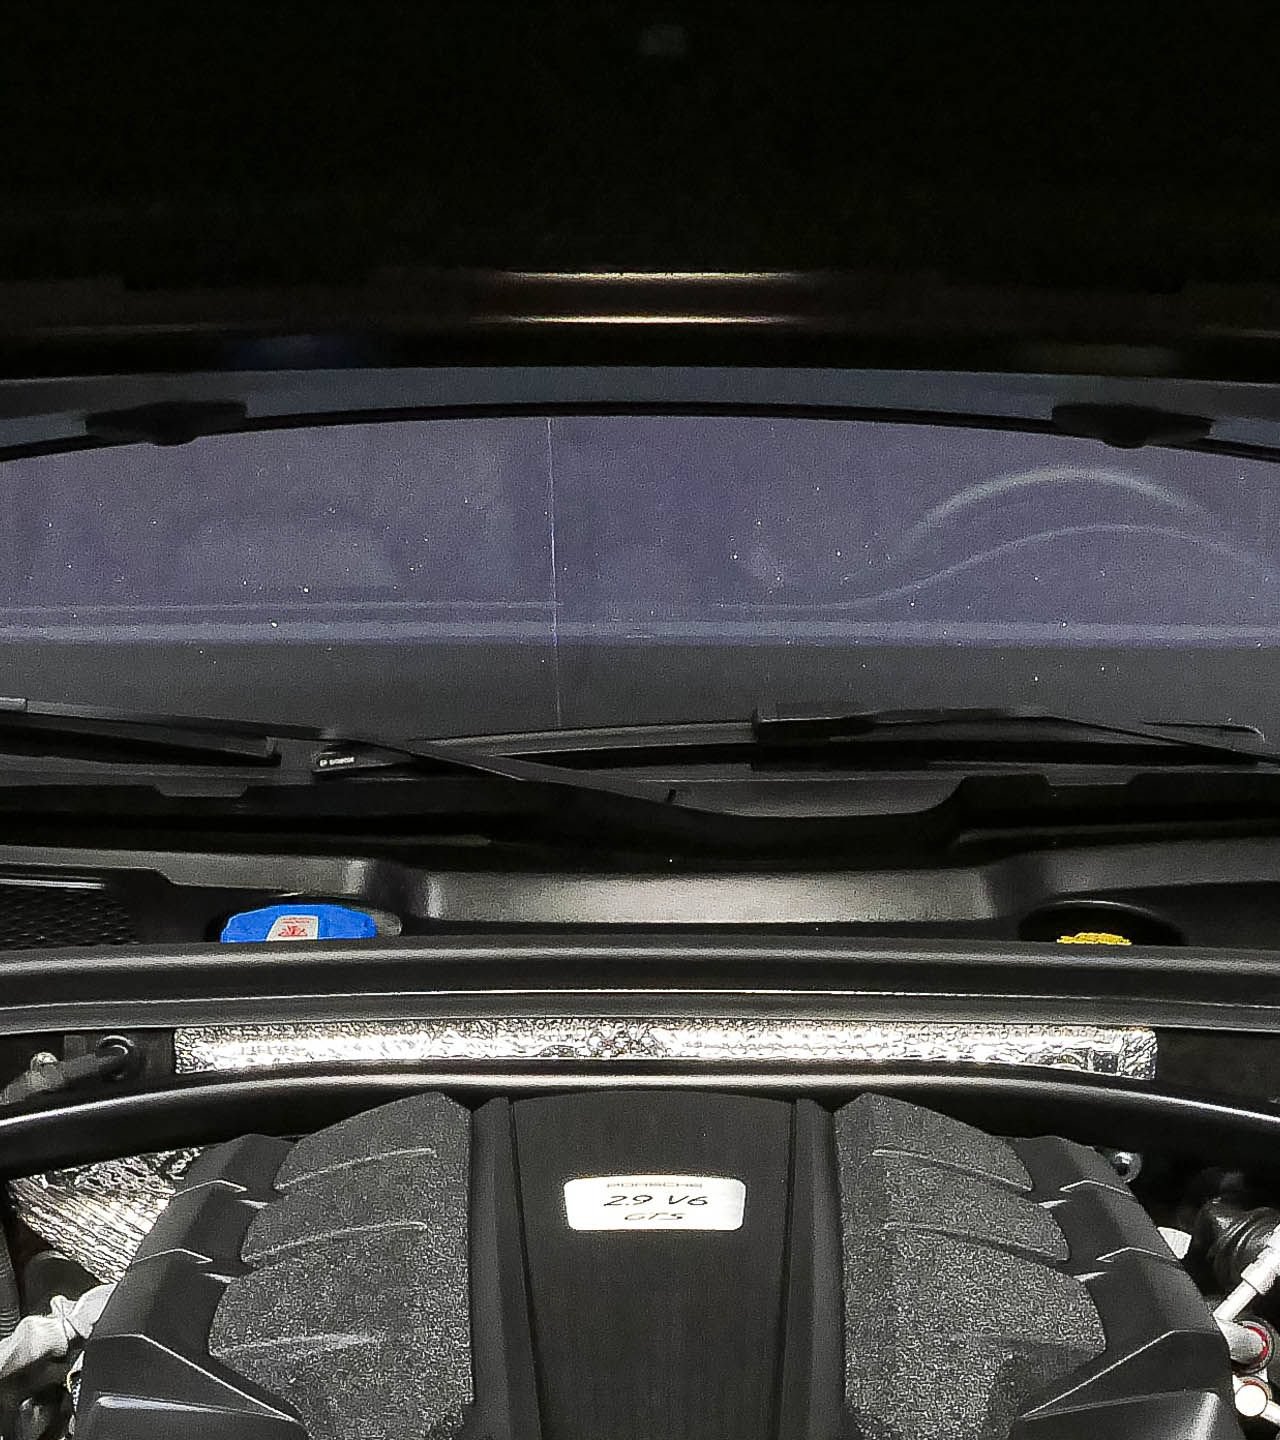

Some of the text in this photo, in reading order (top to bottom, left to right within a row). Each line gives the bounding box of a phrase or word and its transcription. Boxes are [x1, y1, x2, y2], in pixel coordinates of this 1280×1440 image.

[603, 1194, 709, 1207] 2.9 V6
[624, 1212, 686, 1222] GTS
